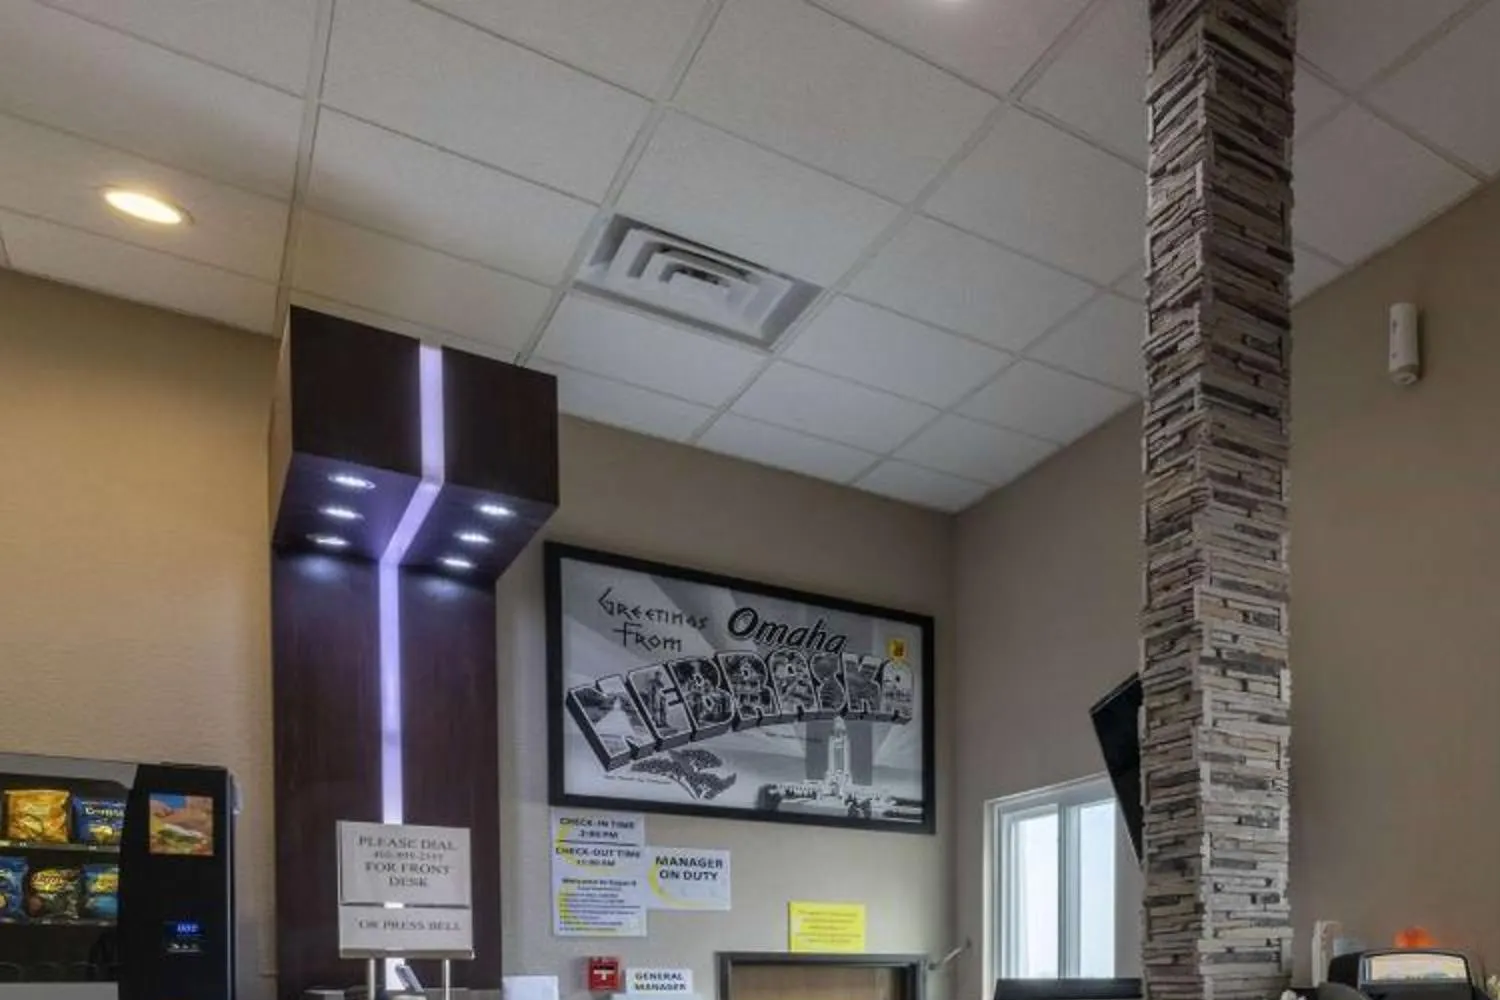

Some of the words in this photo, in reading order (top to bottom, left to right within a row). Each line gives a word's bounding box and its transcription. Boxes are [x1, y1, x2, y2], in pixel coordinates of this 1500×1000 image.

[727, 606, 848, 654] Omaha
[565, 649, 914, 772] NEBRASKA
[358, 835, 417, 848] PLEASE
[421, 839, 457, 851] DIAL
[365, 861, 397, 873] FOR
[401, 862, 453, 875] FRONT
[656, 855, 723, 869] MANAGER
[388, 876, 428, 888] DESK
[659, 870, 680, 880] ON
[683, 871, 719, 882] DUTY
[383, 920, 425, 931] PRESS
[429, 921, 461, 931] BELL
[634, 971, 683, 981] GENERAL
[634, 982, 687, 991] MANAGER
